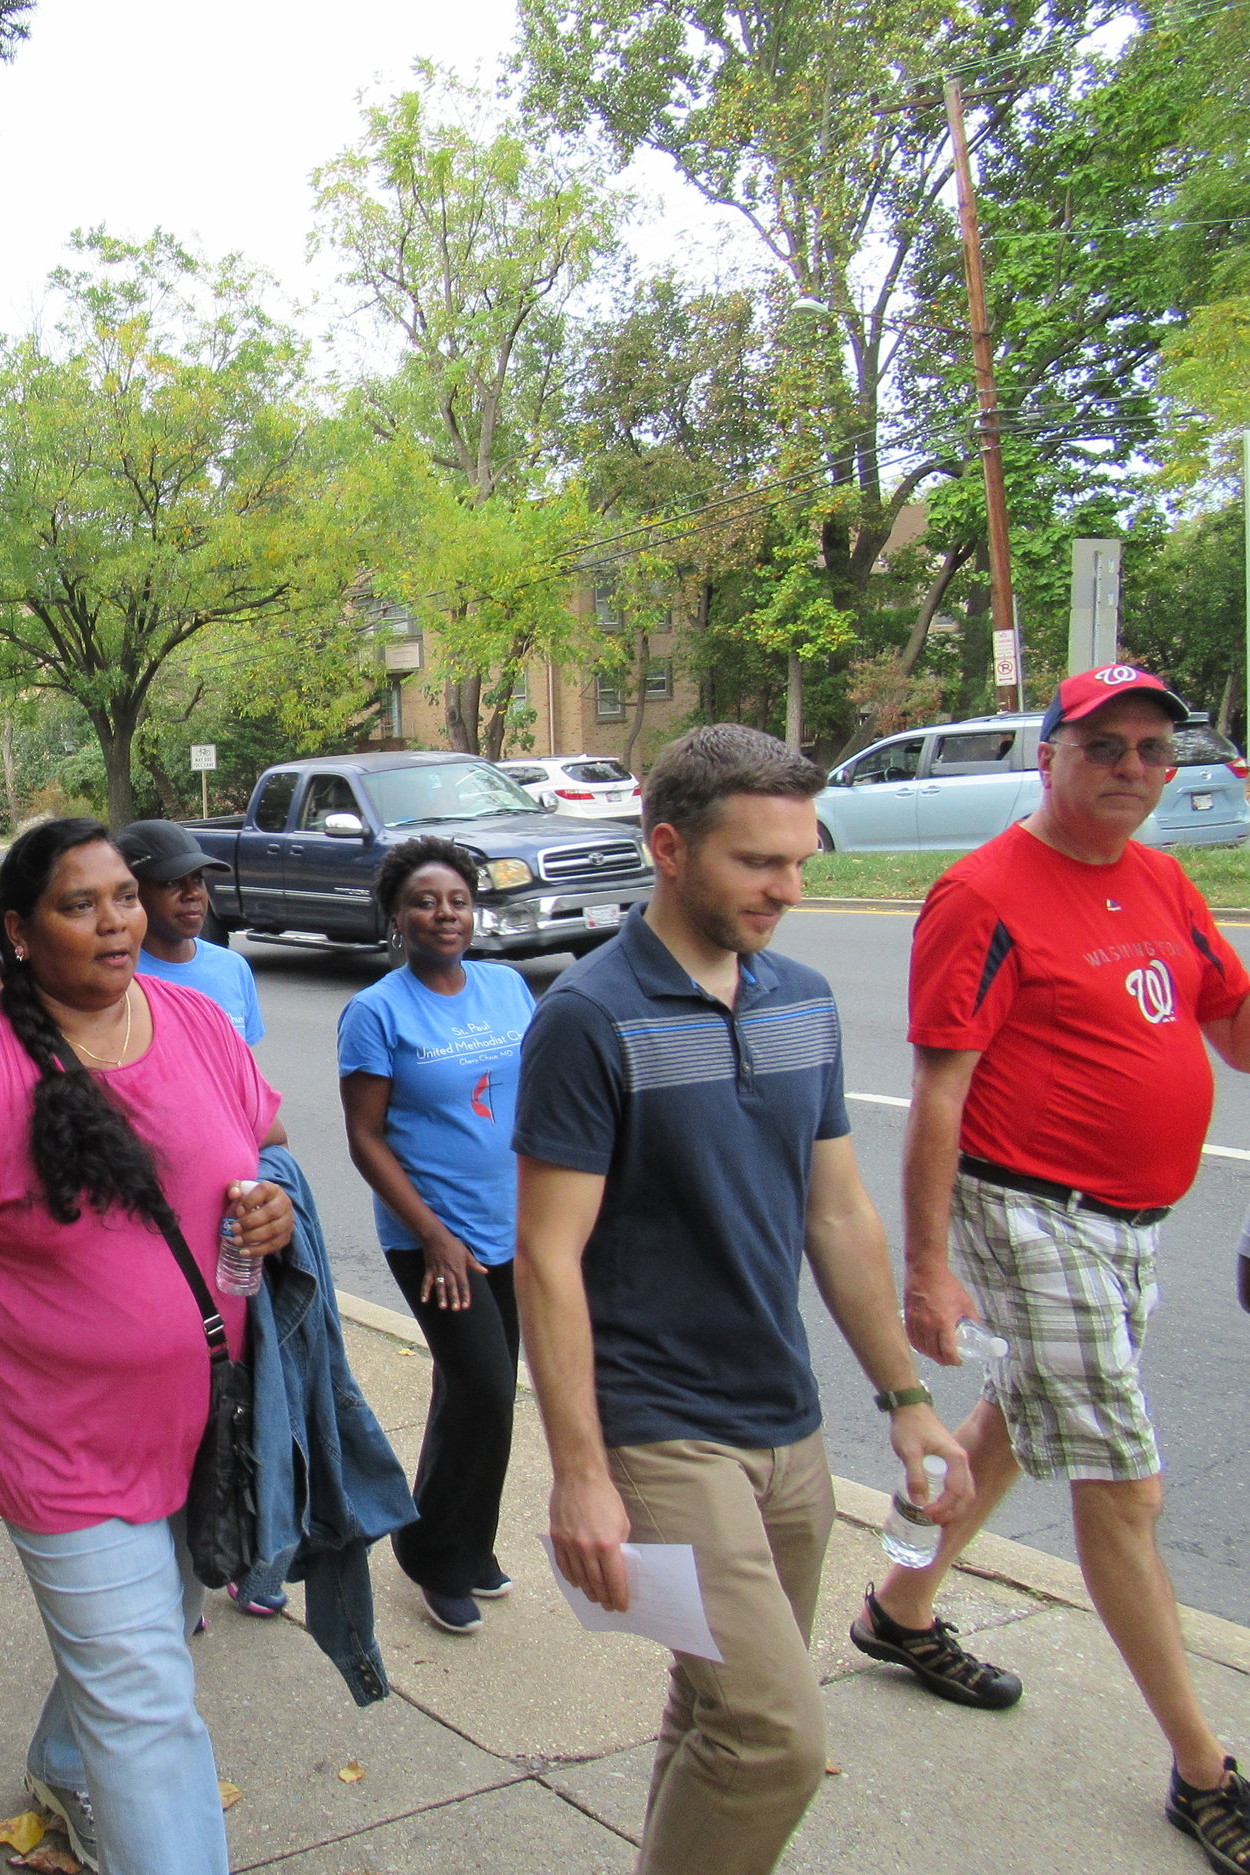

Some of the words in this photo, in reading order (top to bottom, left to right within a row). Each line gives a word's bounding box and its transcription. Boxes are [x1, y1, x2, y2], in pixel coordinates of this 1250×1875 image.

[1094, 665, 1137, 685] W
[1125, 959, 1174, 1024] W
[451, 1027, 468, 1036] St.
[467, 1021, 490, 1033] Paul
[417, 1042, 453, 1059] United
[455, 1035, 507, 1052] Methodist
[459, 1058, 479, 1066] Chevy
